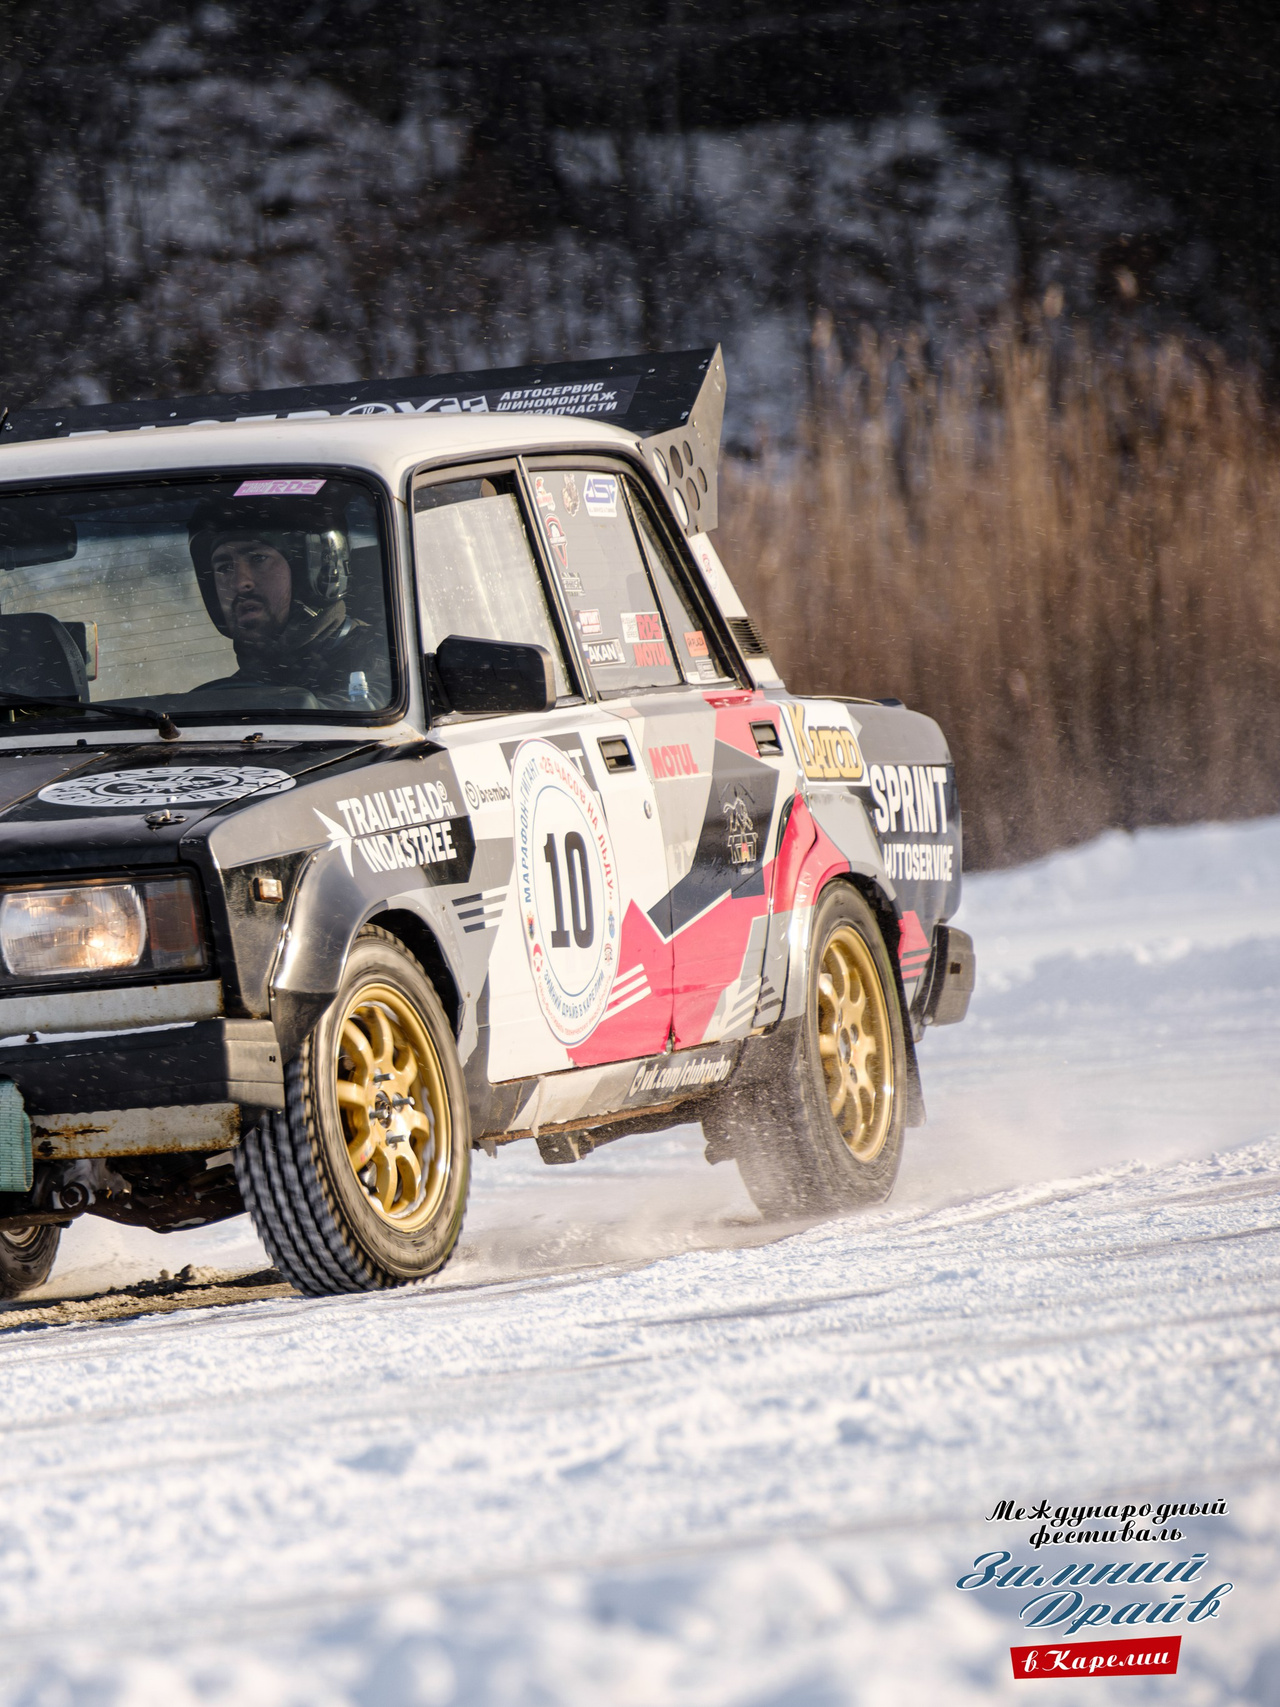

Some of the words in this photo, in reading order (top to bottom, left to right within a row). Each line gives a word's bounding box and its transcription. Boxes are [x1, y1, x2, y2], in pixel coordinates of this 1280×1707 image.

[496, 390, 618, 411] ШИНОМОНТАЖ
[500, 382, 605, 401] АВТОСЕРВИС
[514, 401, 619, 416] ОЗАПЧАСТИ
[268, 480, 320, 493] RDS
[635, 613, 663, 641] RDS
[633, 642, 670, 667] MOTUL
[648, 743, 700, 779] MOTUL
[476, 781, 511, 803] brembo
[553, 760, 587, 805] ЧАСОВ
[587, 802, 599, 831] НА
[870, 764, 948, 834] SPRINT
[543, 831, 595, 949] 10
